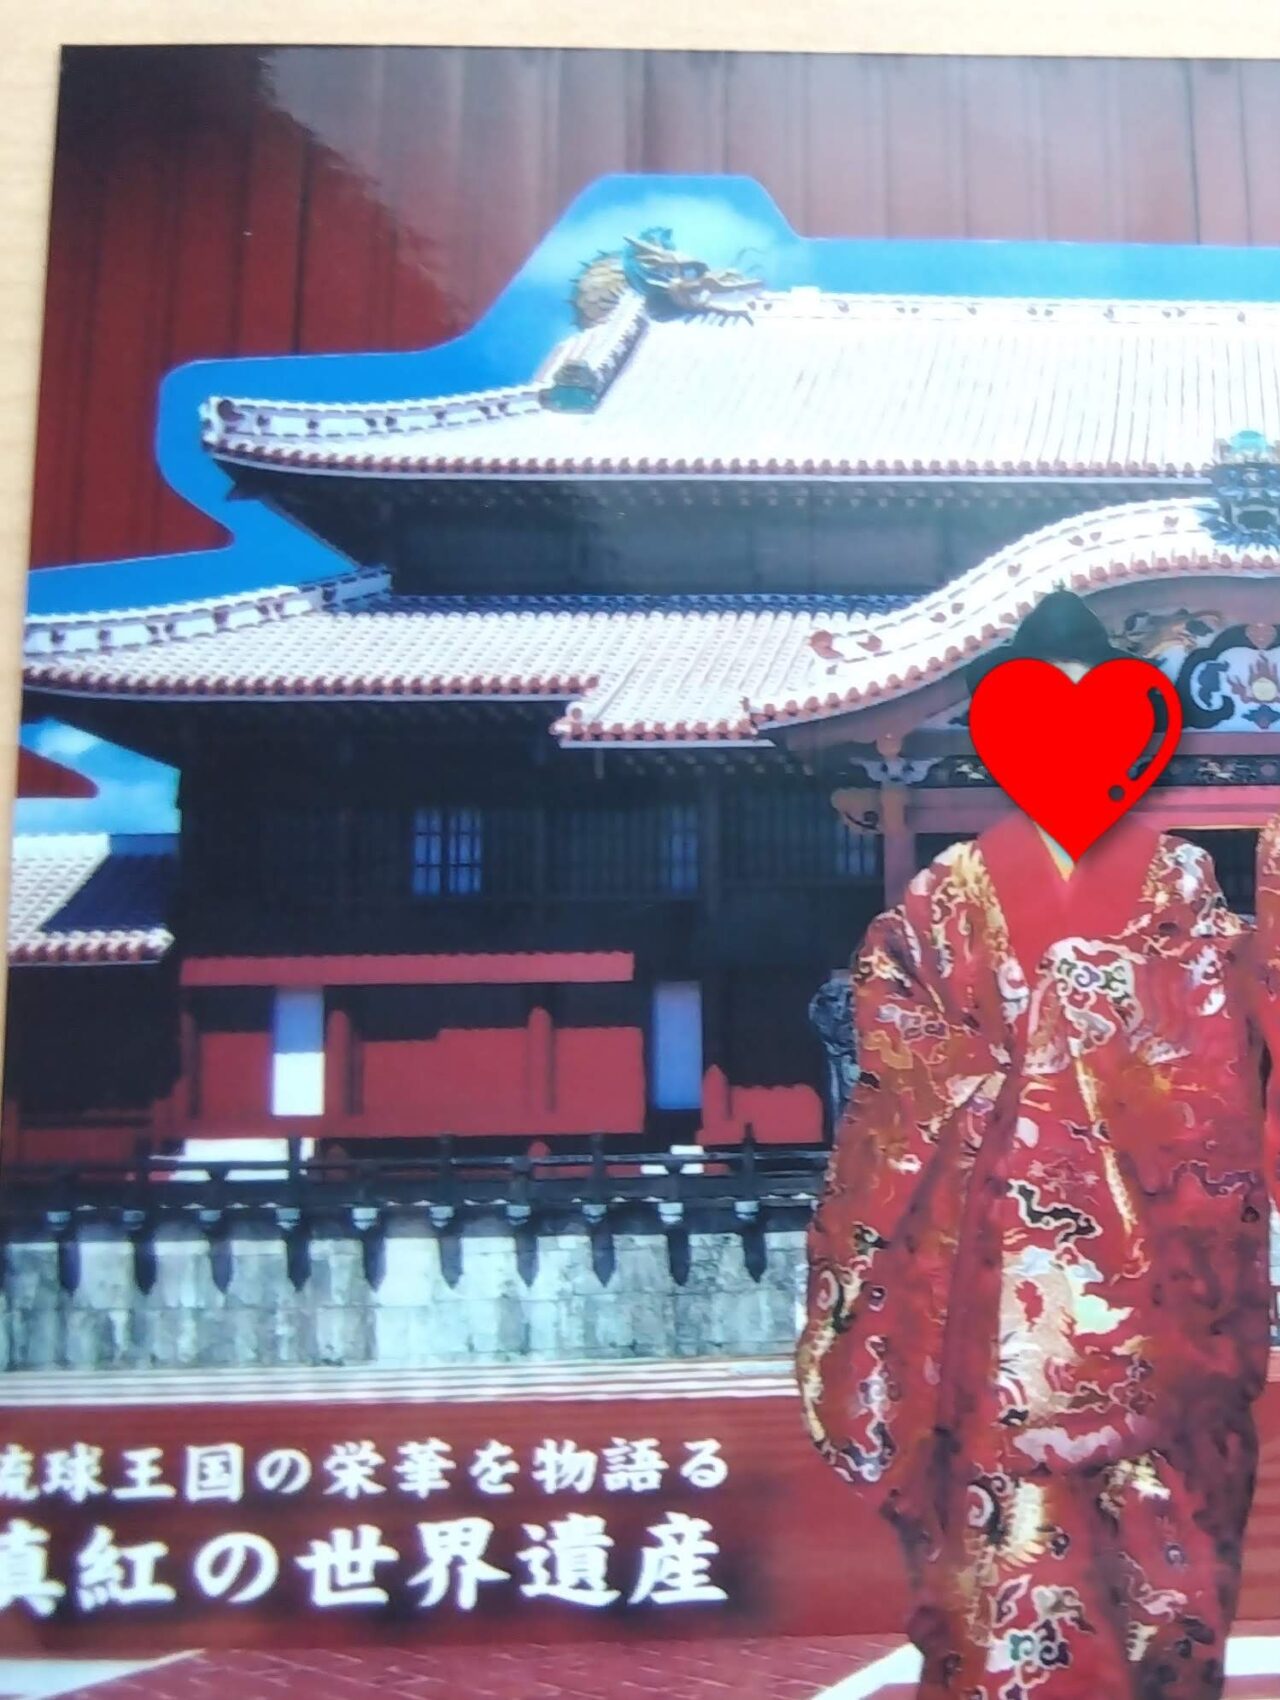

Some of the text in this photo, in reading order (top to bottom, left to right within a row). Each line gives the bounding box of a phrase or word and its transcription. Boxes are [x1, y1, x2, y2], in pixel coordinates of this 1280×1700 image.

[0, 1512, 730, 1617] 真紅の世界遺産
